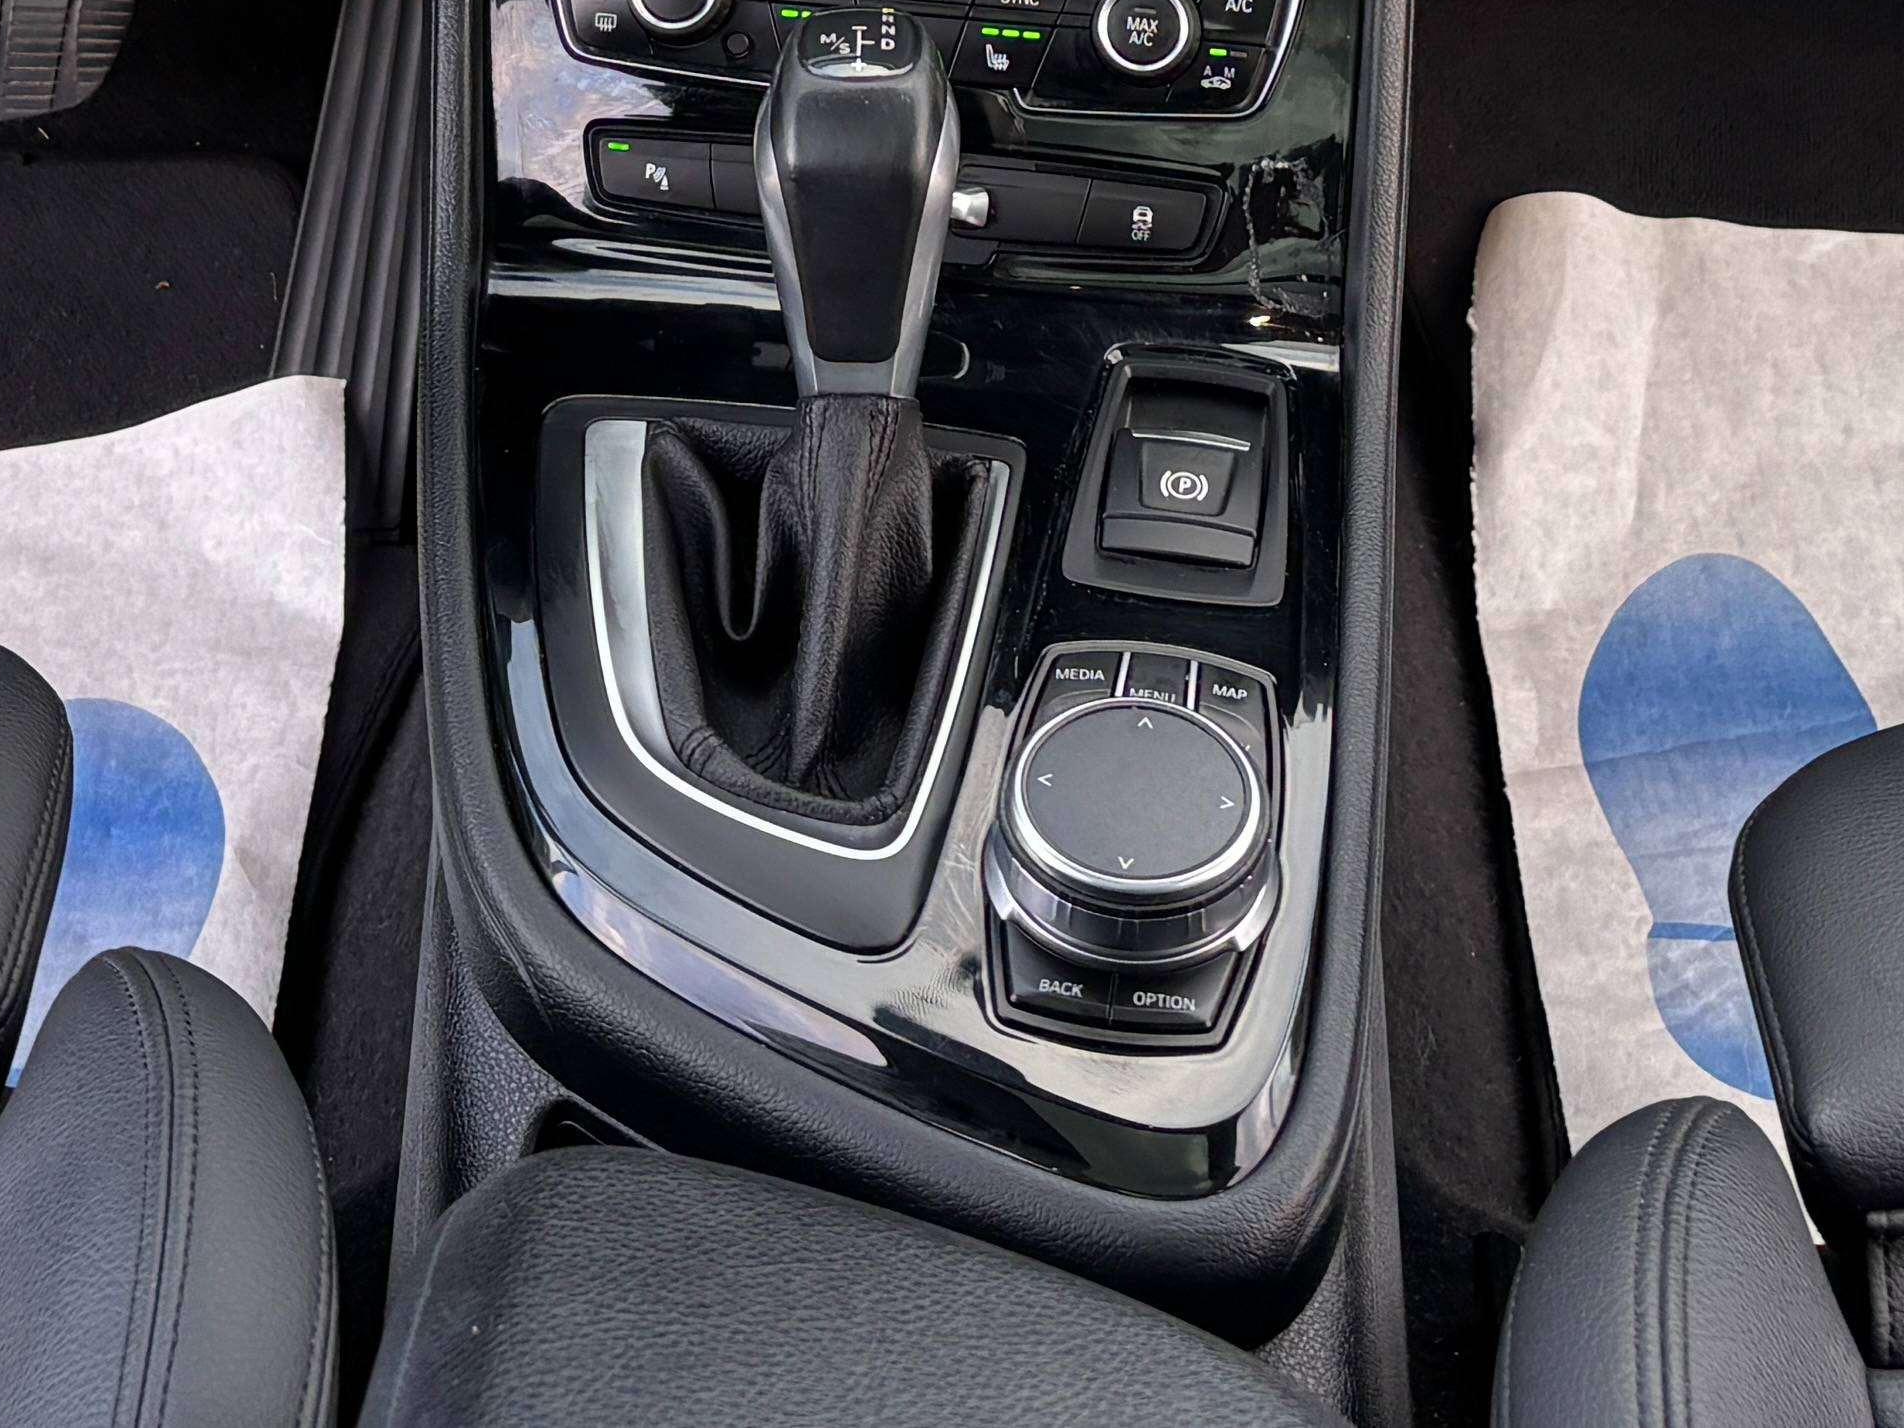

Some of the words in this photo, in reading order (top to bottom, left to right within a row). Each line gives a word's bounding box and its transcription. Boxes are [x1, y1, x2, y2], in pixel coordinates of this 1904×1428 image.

[881, 25, 896, 36] N
[1126, 16, 1159, 33] MAX
[820, 32, 851, 55] M/S
[880, 38, 896, 51] D
[1128, 30, 1154, 47] A/C
[1131, 229, 1151, 241] OFF
[1055, 668, 1105, 681] MEDIA
[1129, 687, 1176, 703] MENU
[1212, 683, 1248, 700] MAP
[1038, 978, 1084, 998] BACK
[1132, 991, 1196, 1012] OPTION
